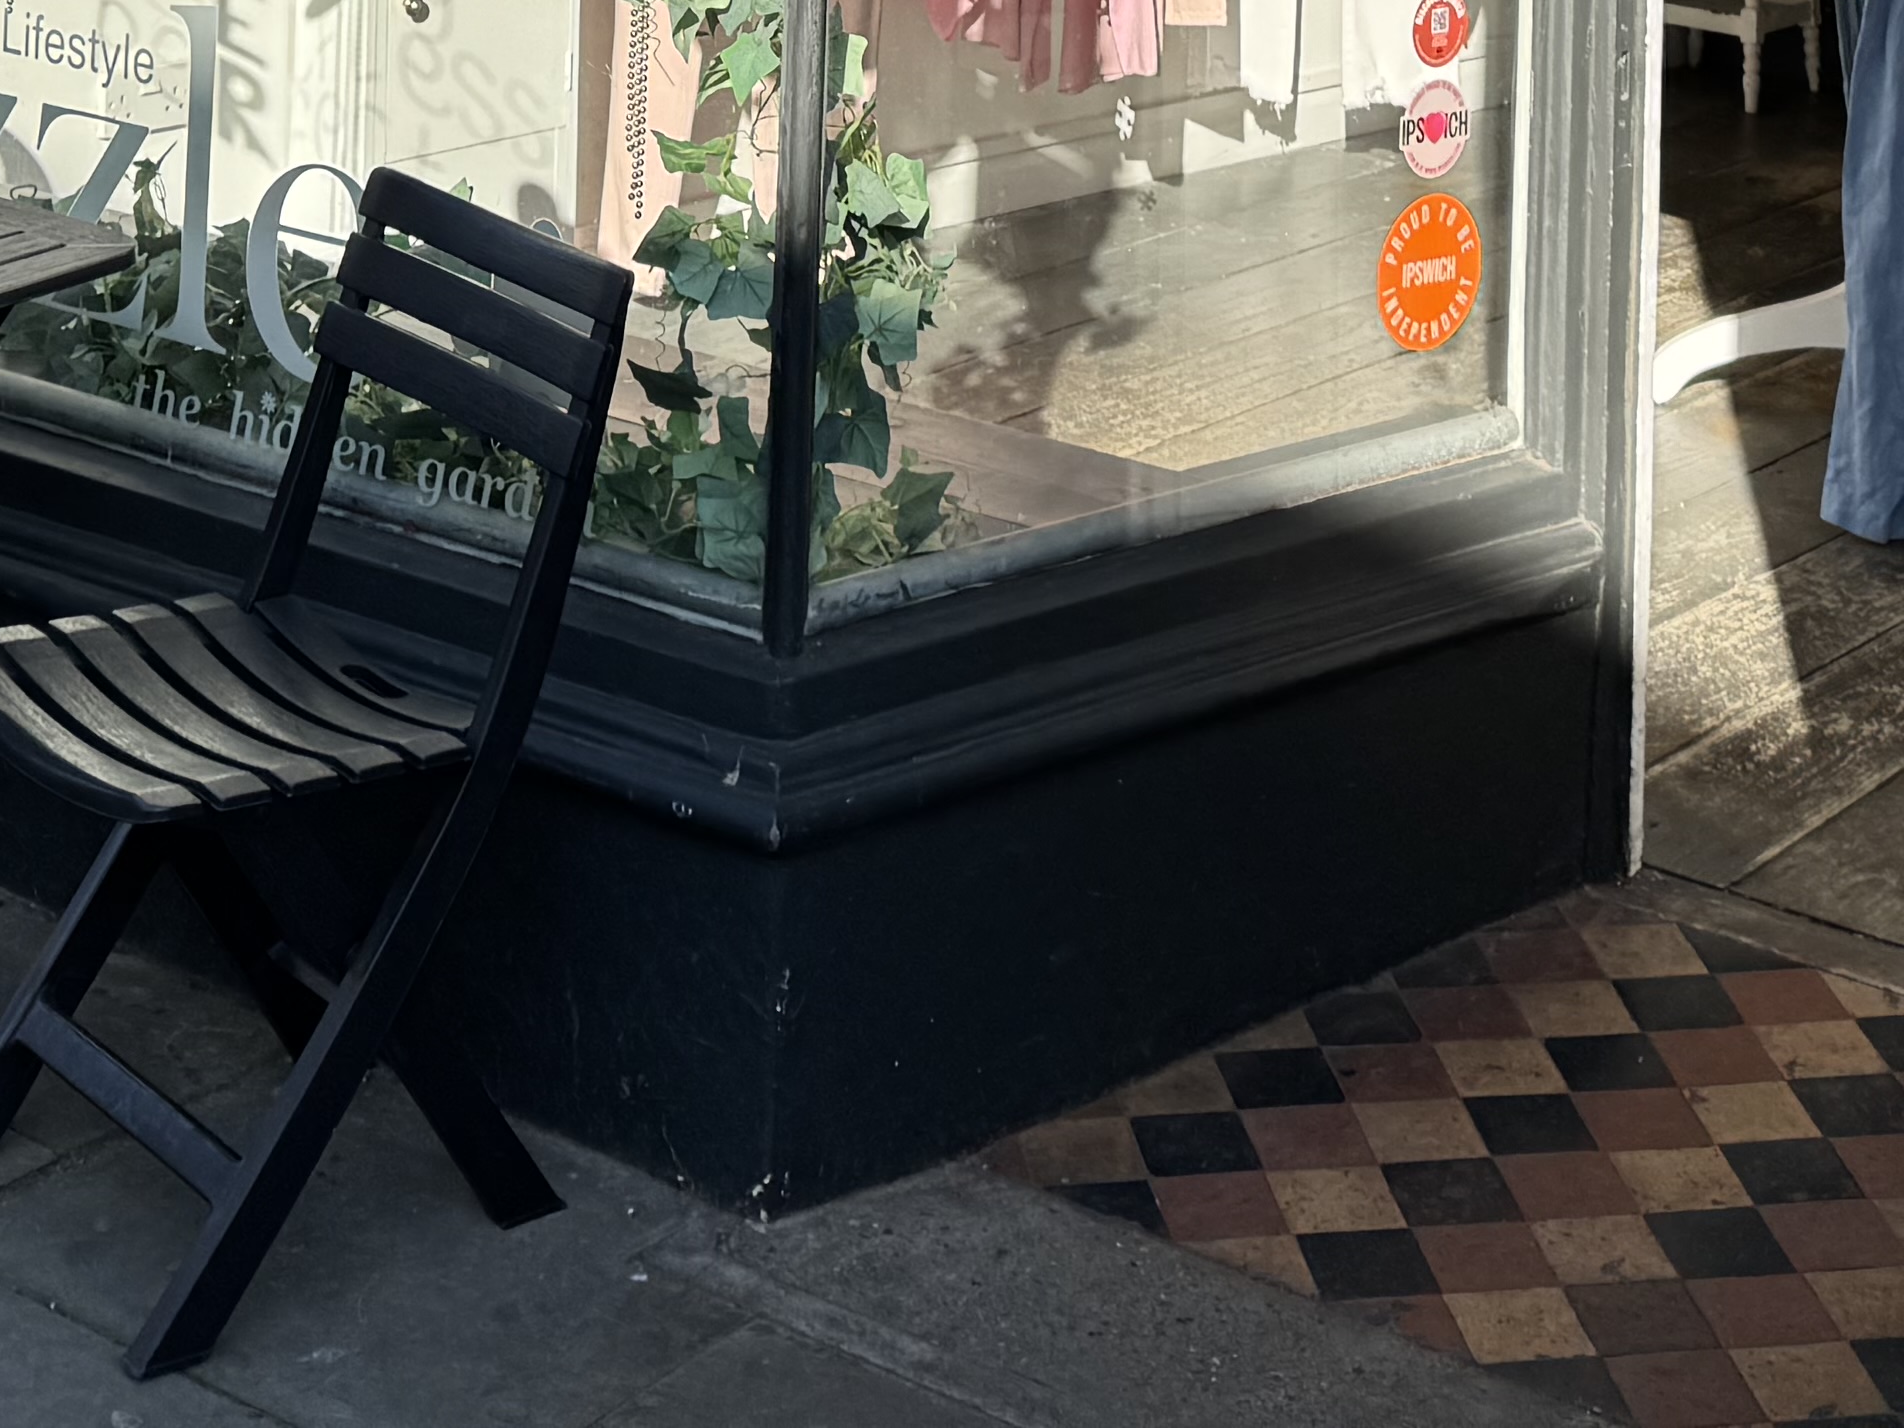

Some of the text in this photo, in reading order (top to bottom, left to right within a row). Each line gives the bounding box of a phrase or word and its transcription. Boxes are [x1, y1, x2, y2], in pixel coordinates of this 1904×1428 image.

[3, 8, 154, 88] Lifestyle
[1385, 202, 1475, 266] PROUD TO BE
[1402, 255, 1456, 288] IPSWICH
[1382, 276, 1473, 343] INDEPENDENT
[134, 370, 201, 427] the
[230, 390, 387, 480] hiden
